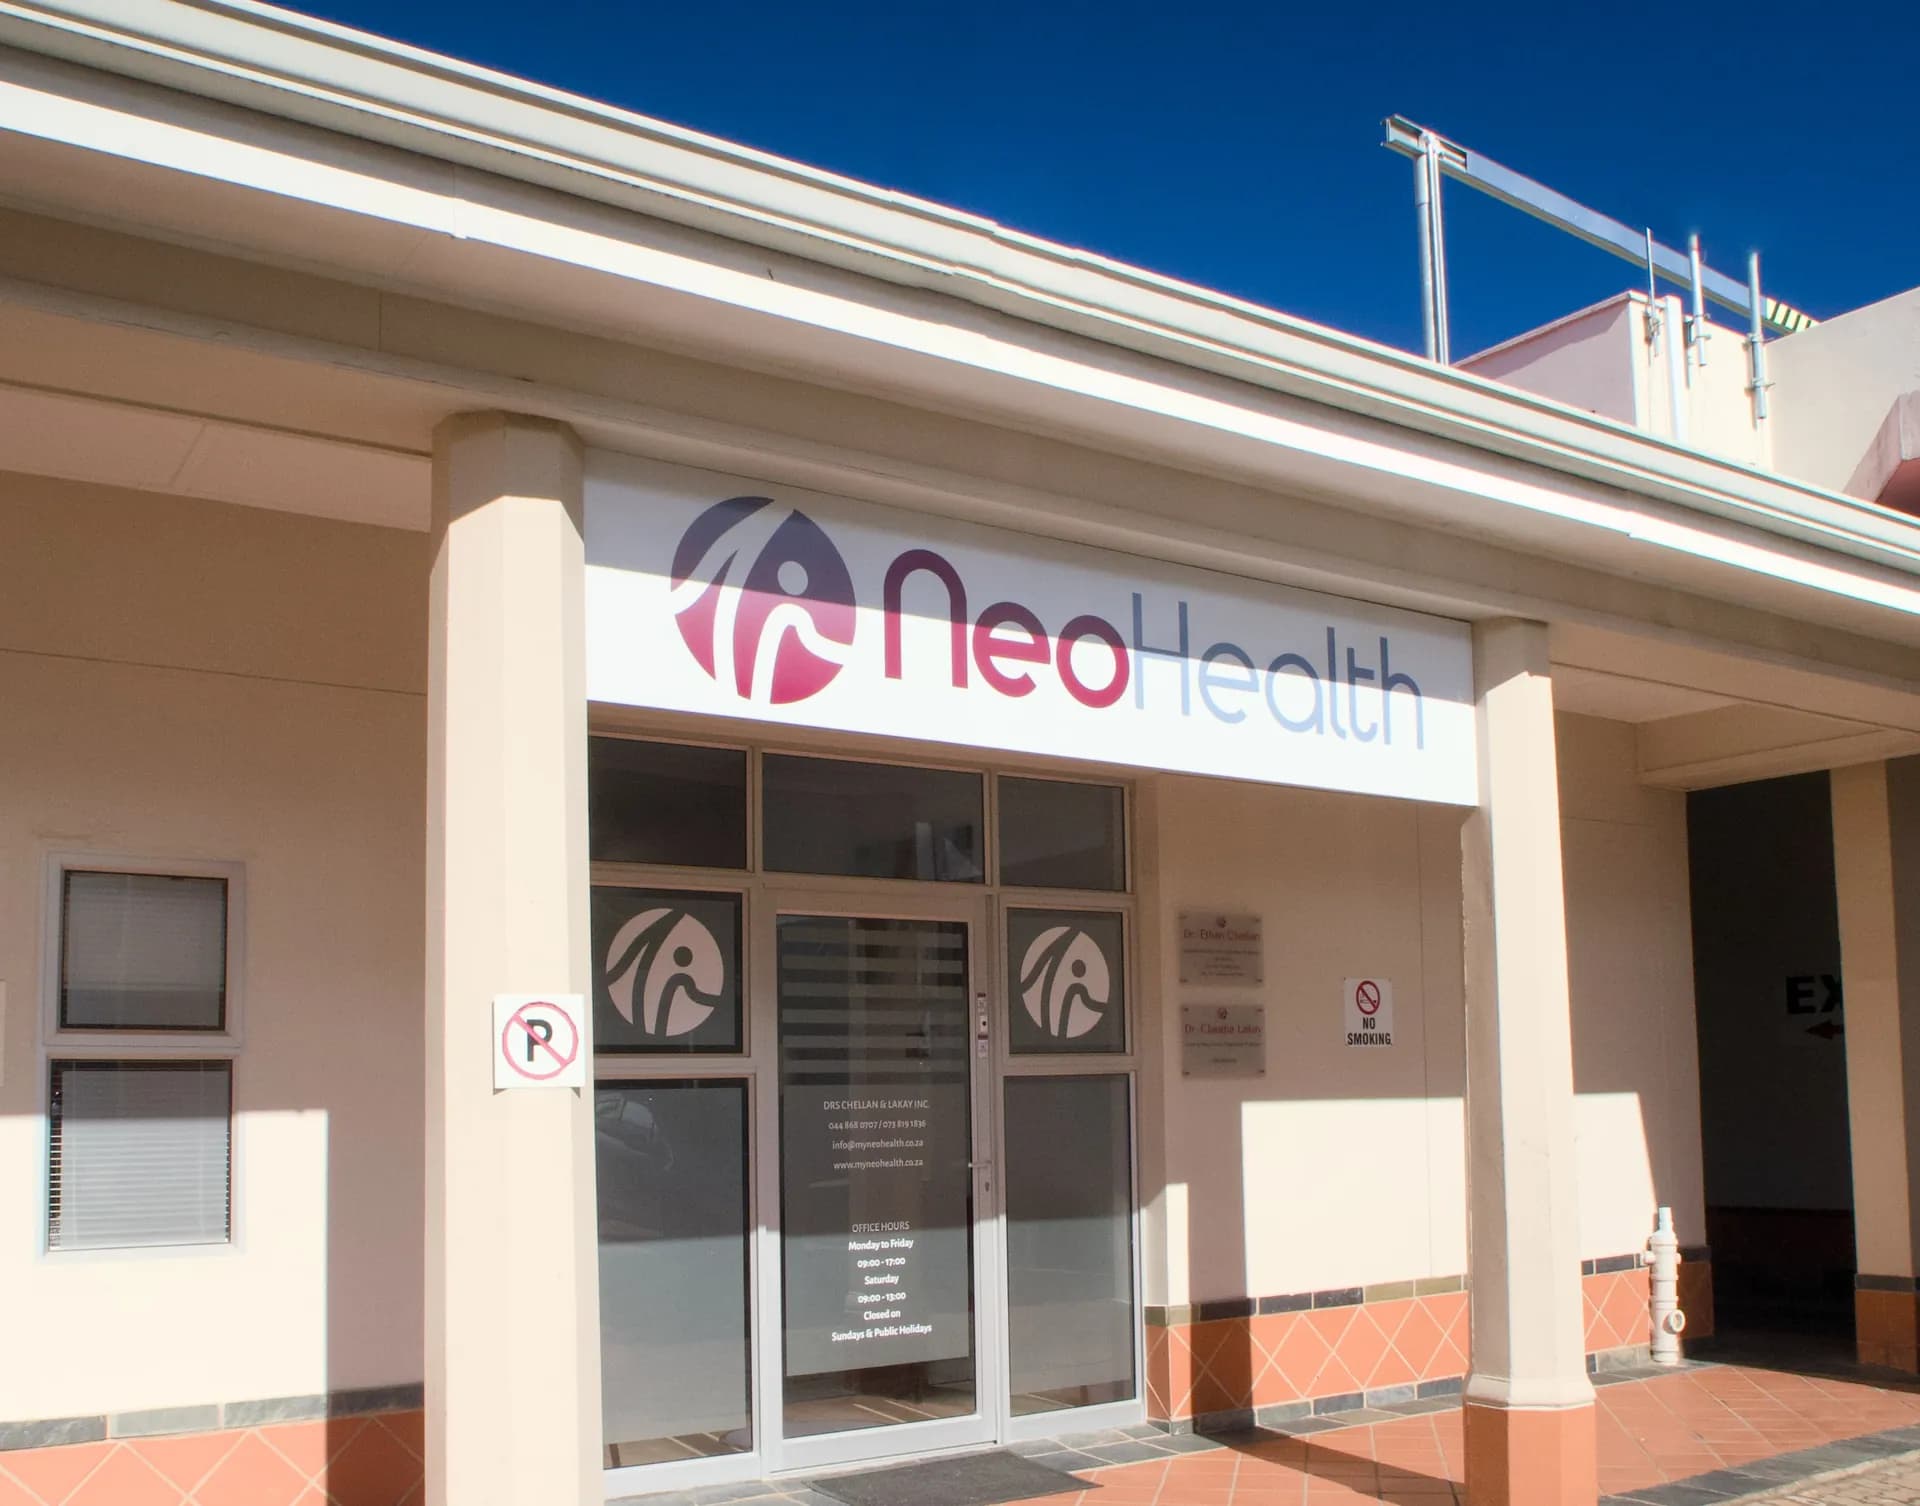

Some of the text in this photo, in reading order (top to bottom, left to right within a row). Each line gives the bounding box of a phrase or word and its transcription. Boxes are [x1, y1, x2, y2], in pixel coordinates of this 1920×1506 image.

[1362, 1017, 1376, 1030] NO
[526, 1019, 553, 1062] P
[1347, 1032, 1392, 1046] SMOKING
[823, 1100, 840, 1110] DRS
[841, 1100, 878, 1110] CHELLAN
[879, 1100, 887, 1109] &
[888, 1099, 914, 1109] LAKAY
[828, 1122, 843, 1131] 044
[832, 1138, 924, 1151] info@myneohealth.co.za
[833, 1158, 923, 1170] www.myneohealth.co.za
[852, 1220, 910, 1233] OFFICE HOURS
[848, 1238, 914, 1251] Monday to Friday
[857, 1259, 880, 1268] 09:00
[885, 1257, 906, 1267] 17:00
[864, 1274, 899, 1285] Saturday
[857, 1294, 881, 1304] 09:00
[885, 1292, 907, 1302] 13:00
[863, 1309, 901, 1320] Closed on
[831, 1323, 932, 1342] Sundays & Public Holidays
